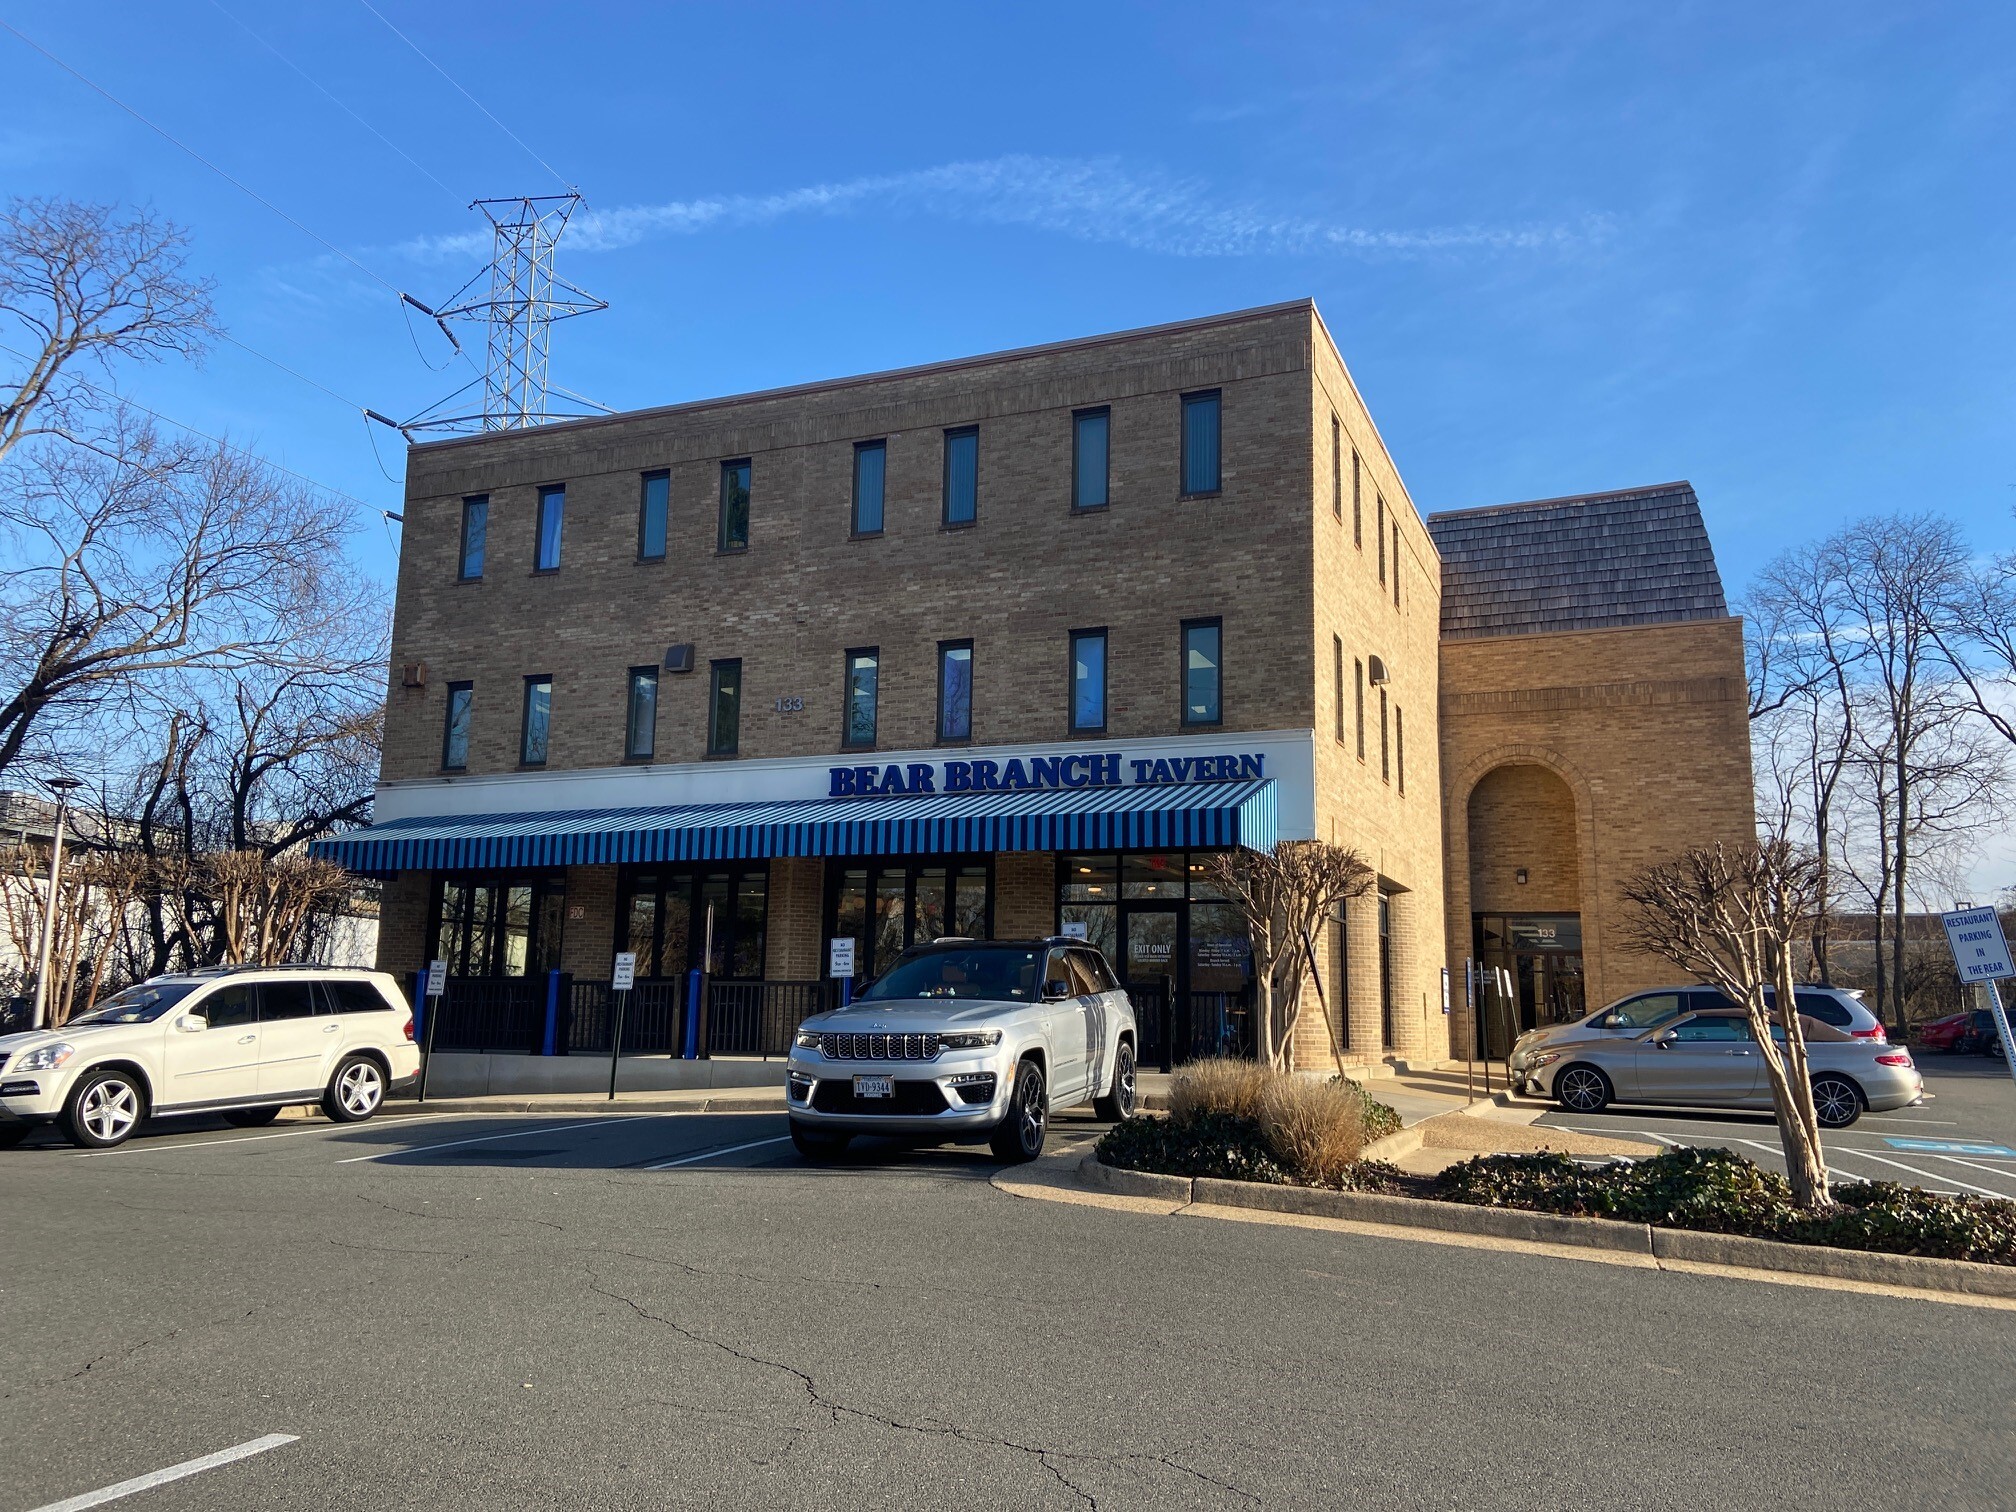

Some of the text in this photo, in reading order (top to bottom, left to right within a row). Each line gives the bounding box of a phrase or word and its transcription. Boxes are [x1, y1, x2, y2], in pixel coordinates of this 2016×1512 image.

[775, 697, 803, 712] 133
[829, 753, 1266, 797] BEAR BRANCH TAVERN
[1946, 912, 1994, 928] RESTAURANT
[1537, 928, 1556, 938] 133
[1959, 929, 1993, 943] PARKING
[1134, 944, 1171, 954] EXIT ONLY
[1975, 947, 1986, 958] IN
[1967, 961, 2005, 976] THE REAR
